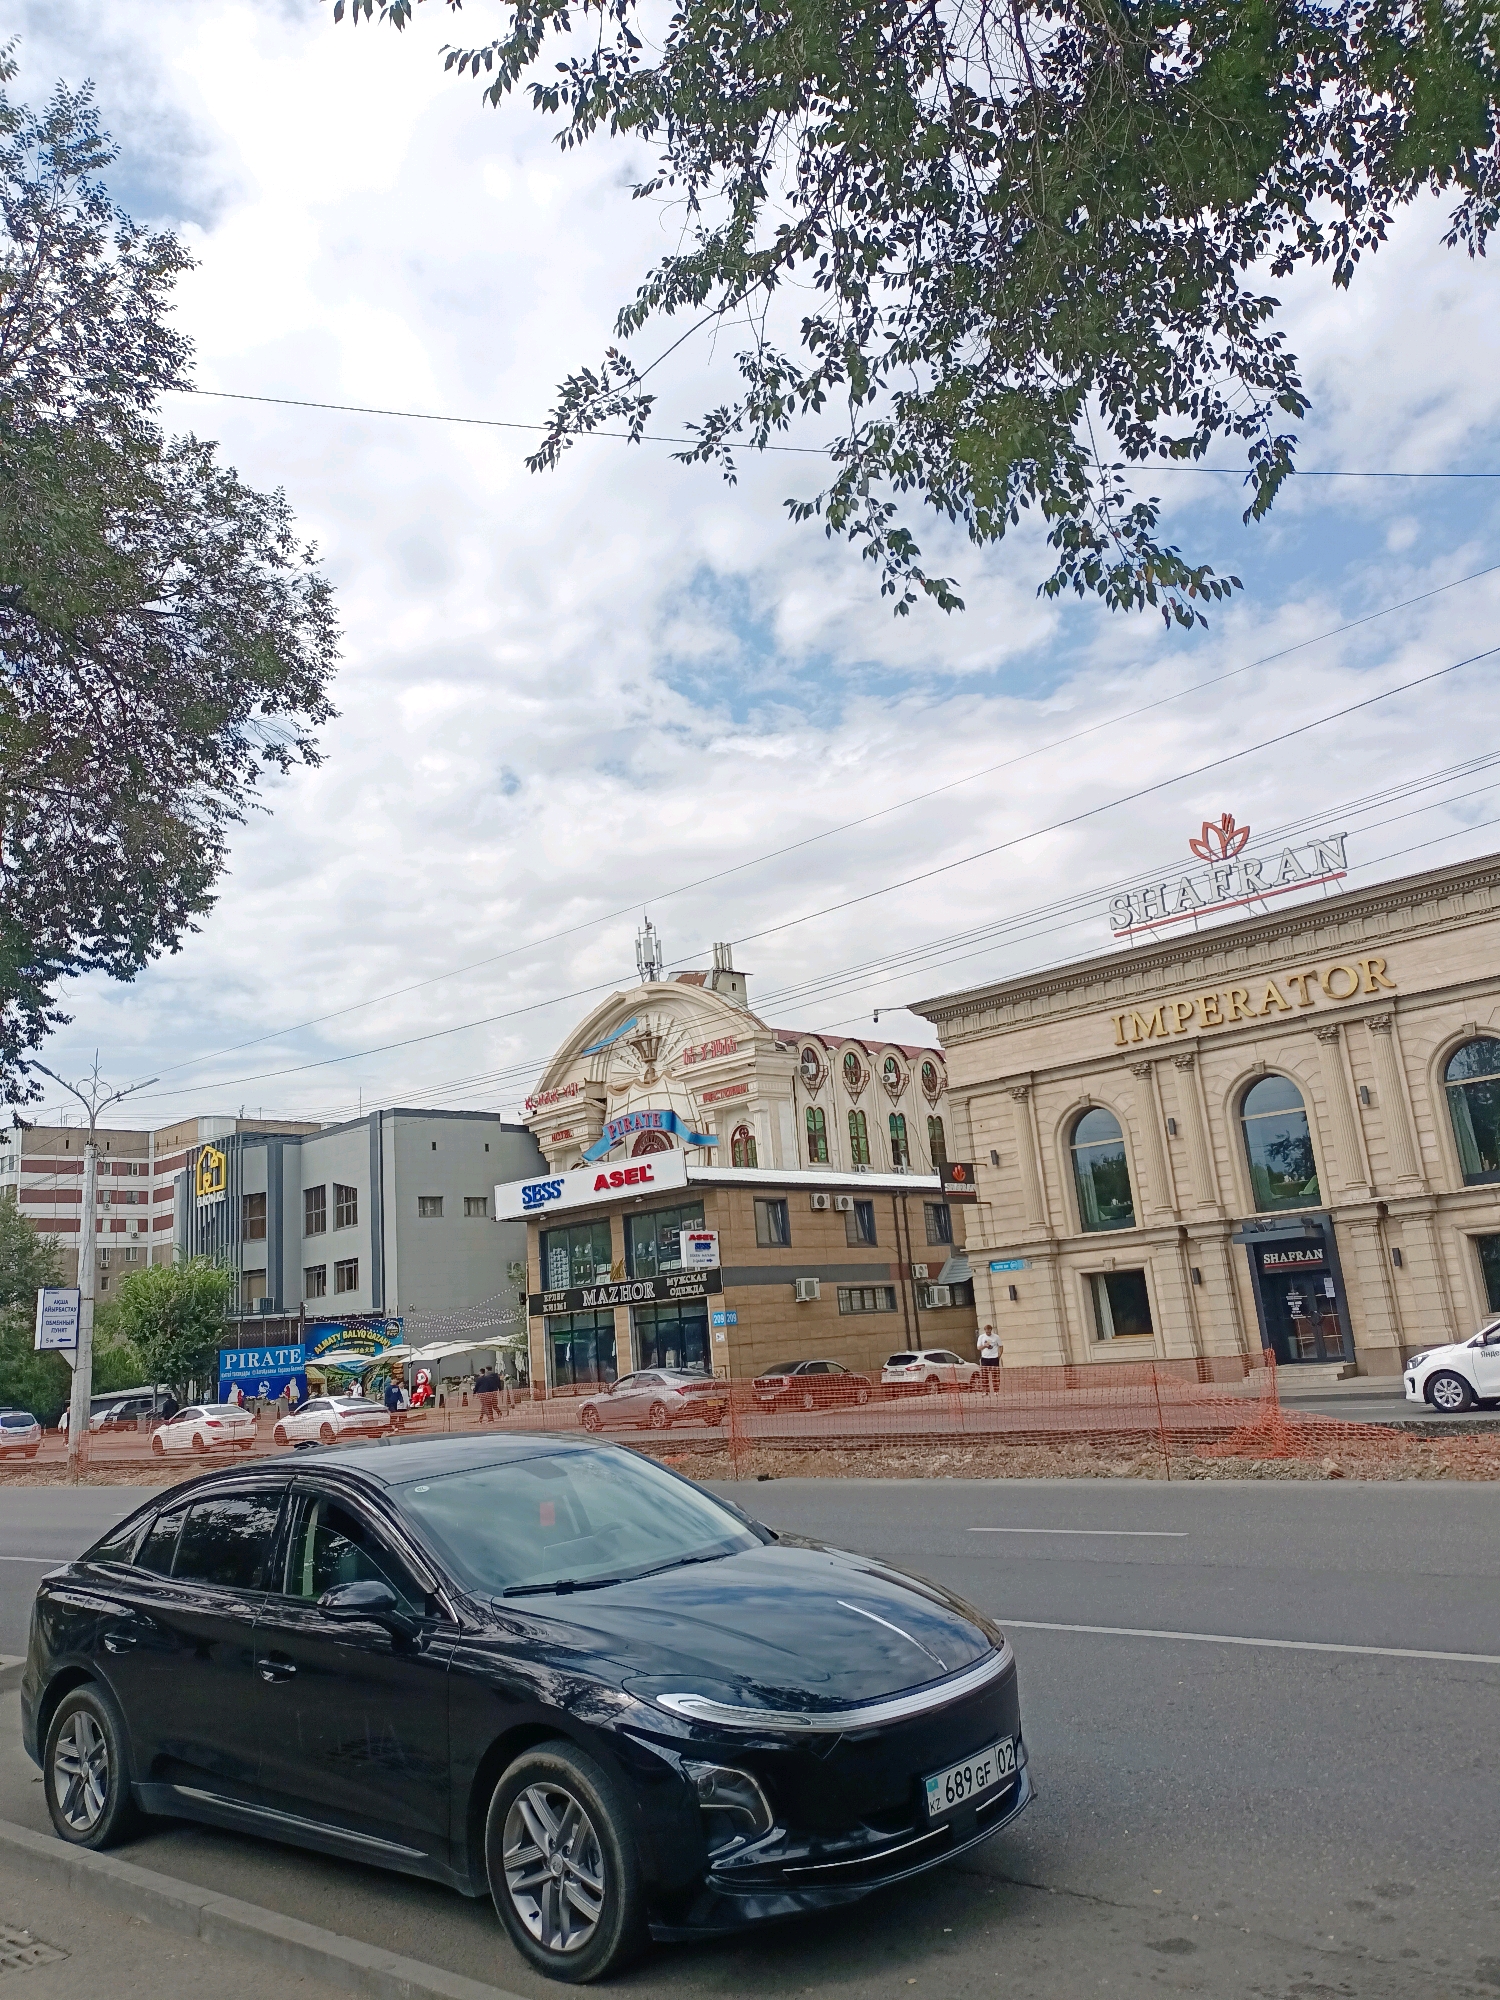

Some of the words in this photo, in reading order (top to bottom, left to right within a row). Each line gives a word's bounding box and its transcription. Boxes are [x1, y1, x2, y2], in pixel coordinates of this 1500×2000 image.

[1109, 832, 1348, 930] SHAFRAN
[1111, 957, 1397, 1046] IMPERATOR
[607, 1113, 662, 1140] PIRATE
[594, 1164, 654, 1191] ASEL
[522, 1179, 564, 1205] SESS
[1264, 1249, 1323, 1264] SHAFRAN
[666, 1273, 707, 1287] МУЖСКАЯ
[670, 1284, 704, 1297] ОДЕЖДА
[582, 1282, 656, 1307] MAZHOR
[713, 1314, 725, 1324] 209
[727, 1313, 737, 1323] 209
[314, 1333, 341, 1354] ALMATY
[225, 1349, 301, 1369] PIRATE
[945, 1766, 972, 1803] 689
[975, 1761, 991, 1787] GF
[998, 1743, 1015, 1774] 02
[930, 1797, 942, 1813] KZ
